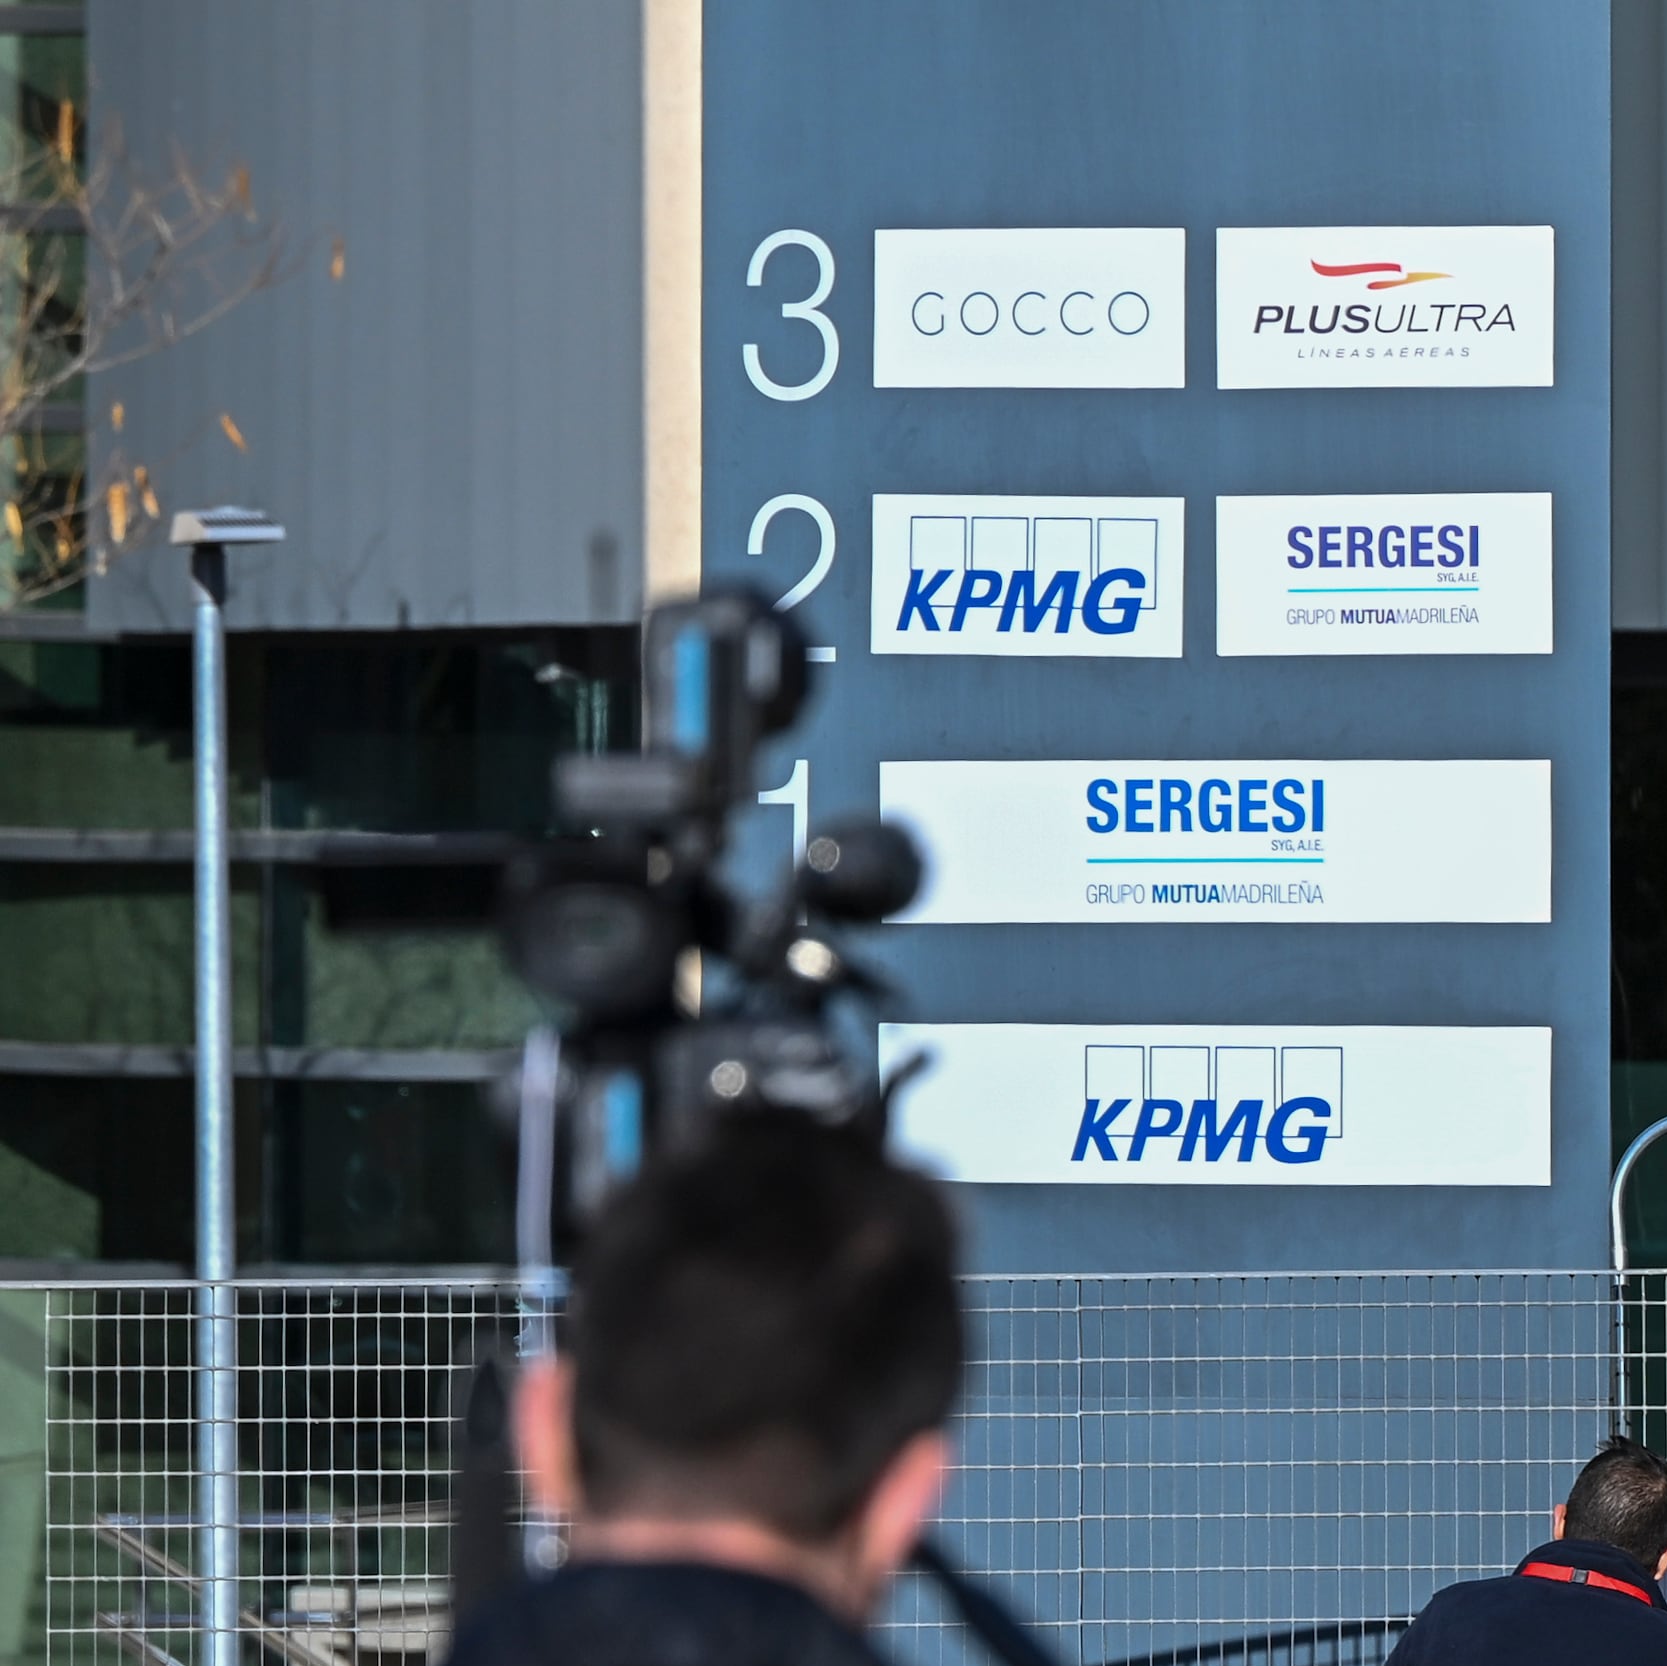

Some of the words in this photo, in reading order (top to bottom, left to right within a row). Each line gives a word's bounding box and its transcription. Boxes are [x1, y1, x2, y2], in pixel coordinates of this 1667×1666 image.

[743, 229, 839, 401] 3
[912, 291, 1150, 336] GOCCO
[1287, 525, 1480, 569] SERGESI
[896, 567, 1146, 635] KPMG
[1287, 608, 1336, 625] GRUPO
[1086, 778, 1325, 834] SERGESI
[1086, 884, 1146, 904] GRUPO
[1070, 1096, 1332, 1164] KPMG
